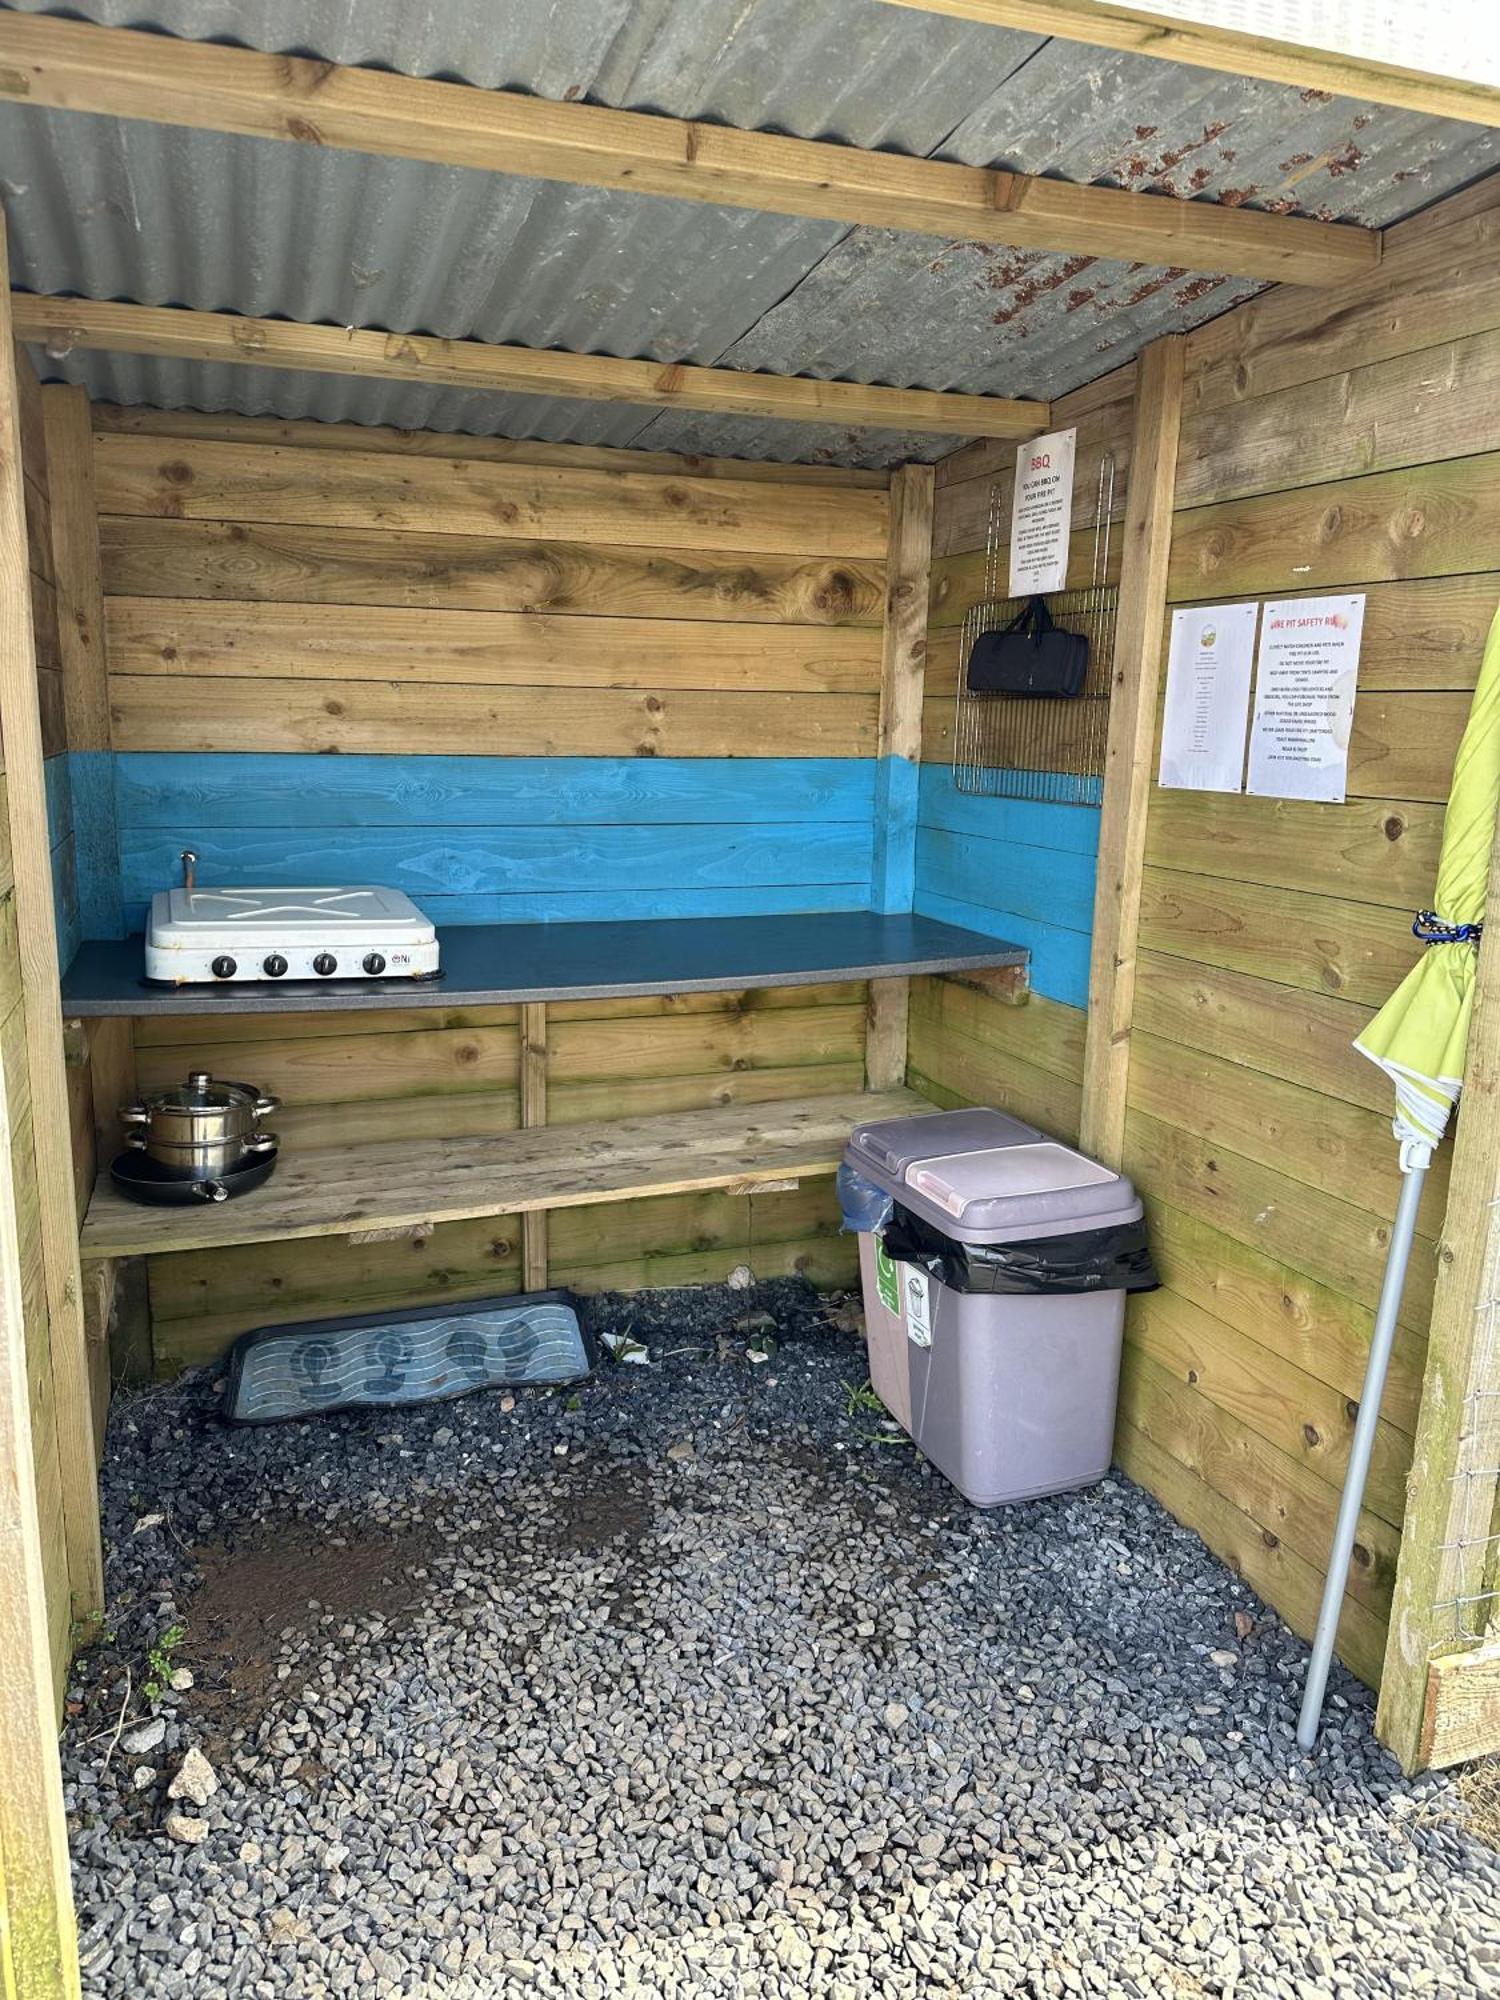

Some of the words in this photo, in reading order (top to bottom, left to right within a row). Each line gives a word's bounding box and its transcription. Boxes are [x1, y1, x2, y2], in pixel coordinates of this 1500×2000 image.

[1031, 454, 1050, 471] BBQ
[1286, 619, 1296, 629] PIT
[1298, 617, 1323, 628] SAFETY
